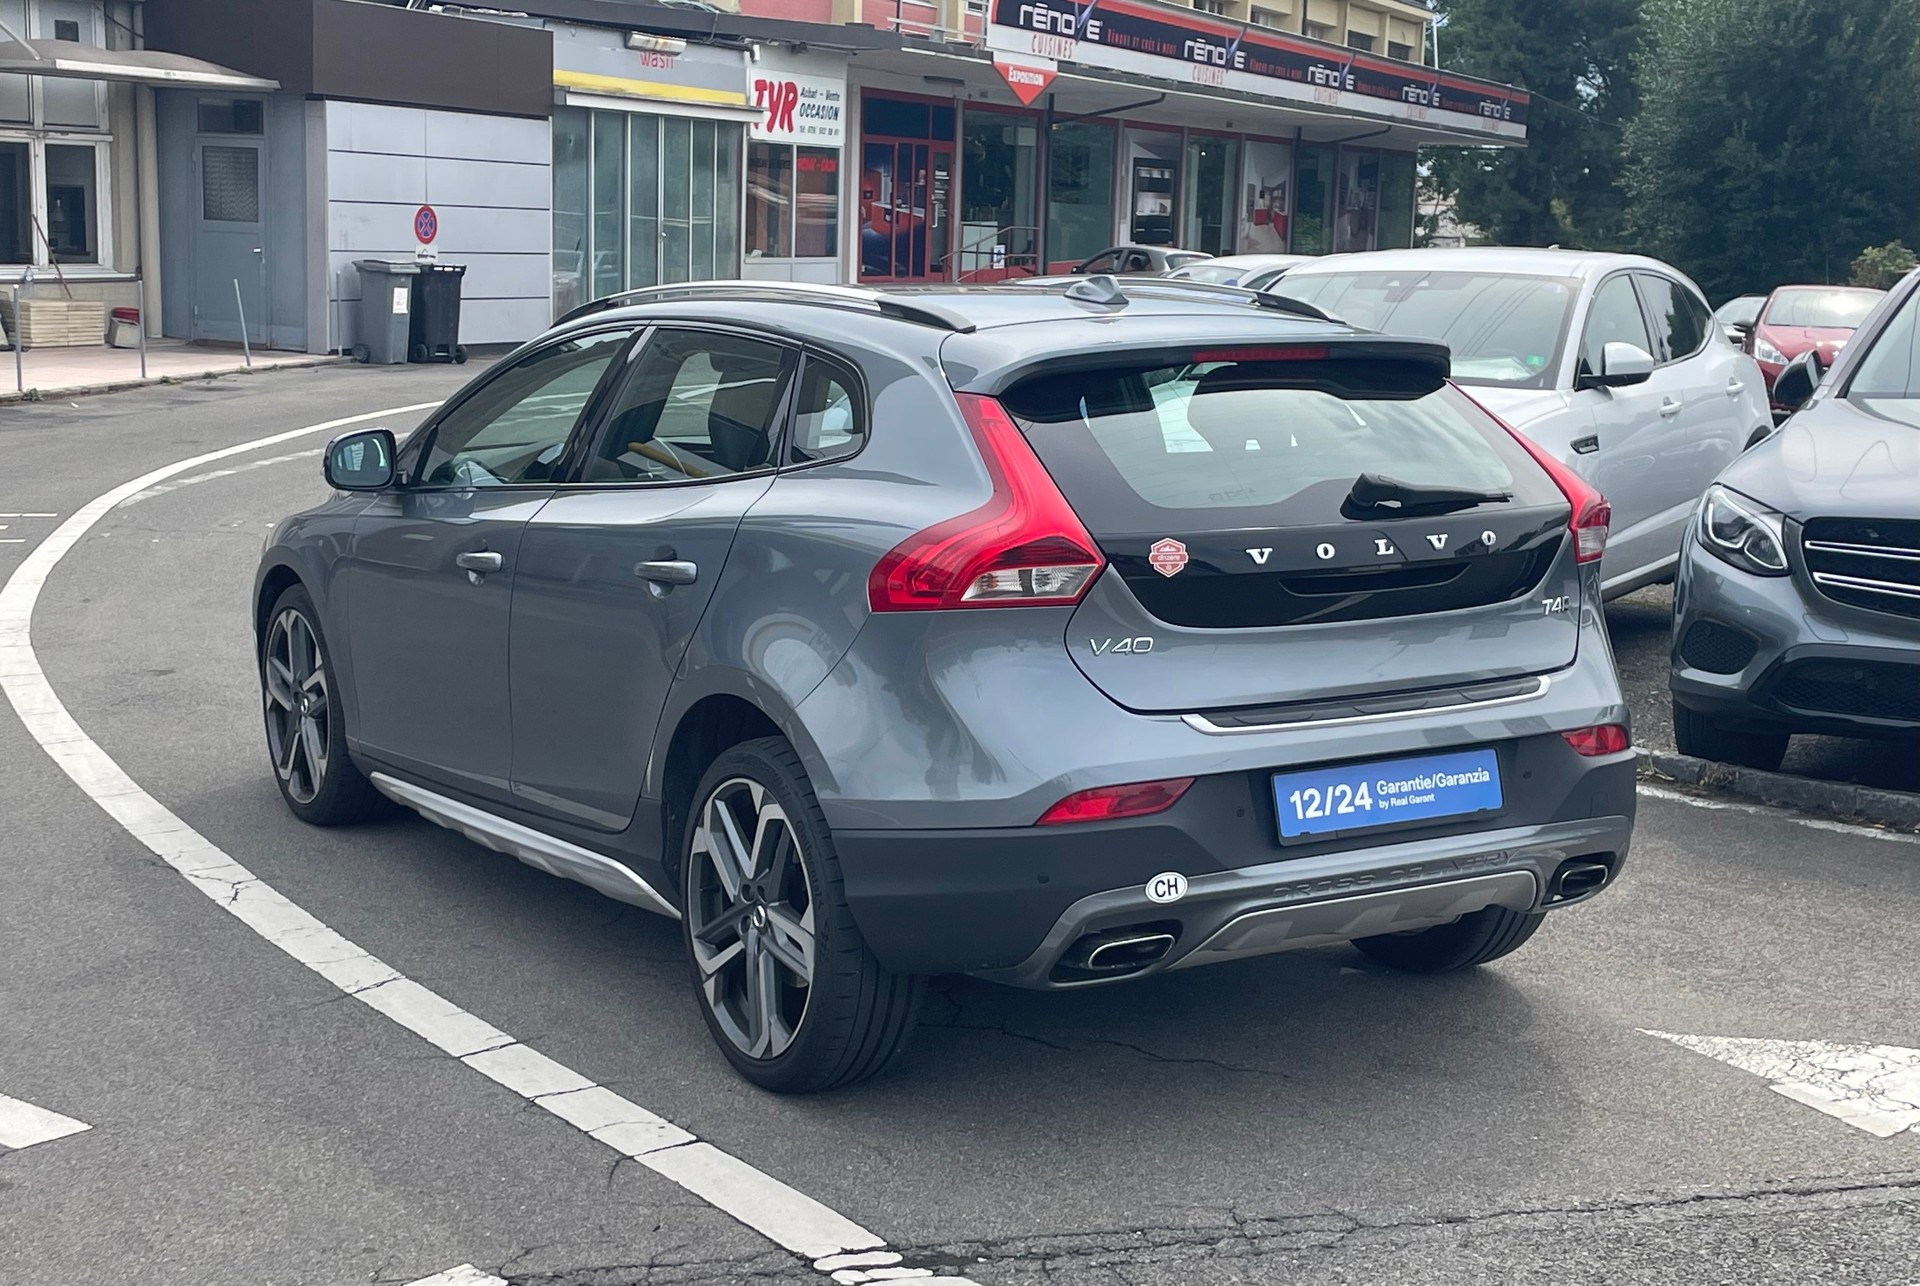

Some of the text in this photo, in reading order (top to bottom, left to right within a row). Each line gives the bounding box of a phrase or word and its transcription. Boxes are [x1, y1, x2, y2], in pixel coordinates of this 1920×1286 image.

[1031, 34, 1073, 59] CUISINES
[800, 87, 818, 99] Achat
[826, 90, 840, 101] Vente
[753, 79, 798, 133] TYR
[800, 102, 840, 120] OCCASION
[1246, 530, 1497, 565] VOLVO
[1089, 636, 1153, 656] V40
[1289, 767, 1490, 820] 12/24 Garantie/Garanzia
[1379, 792, 1436, 810] by Real Garant
[1155, 877, 1178, 898] CH
